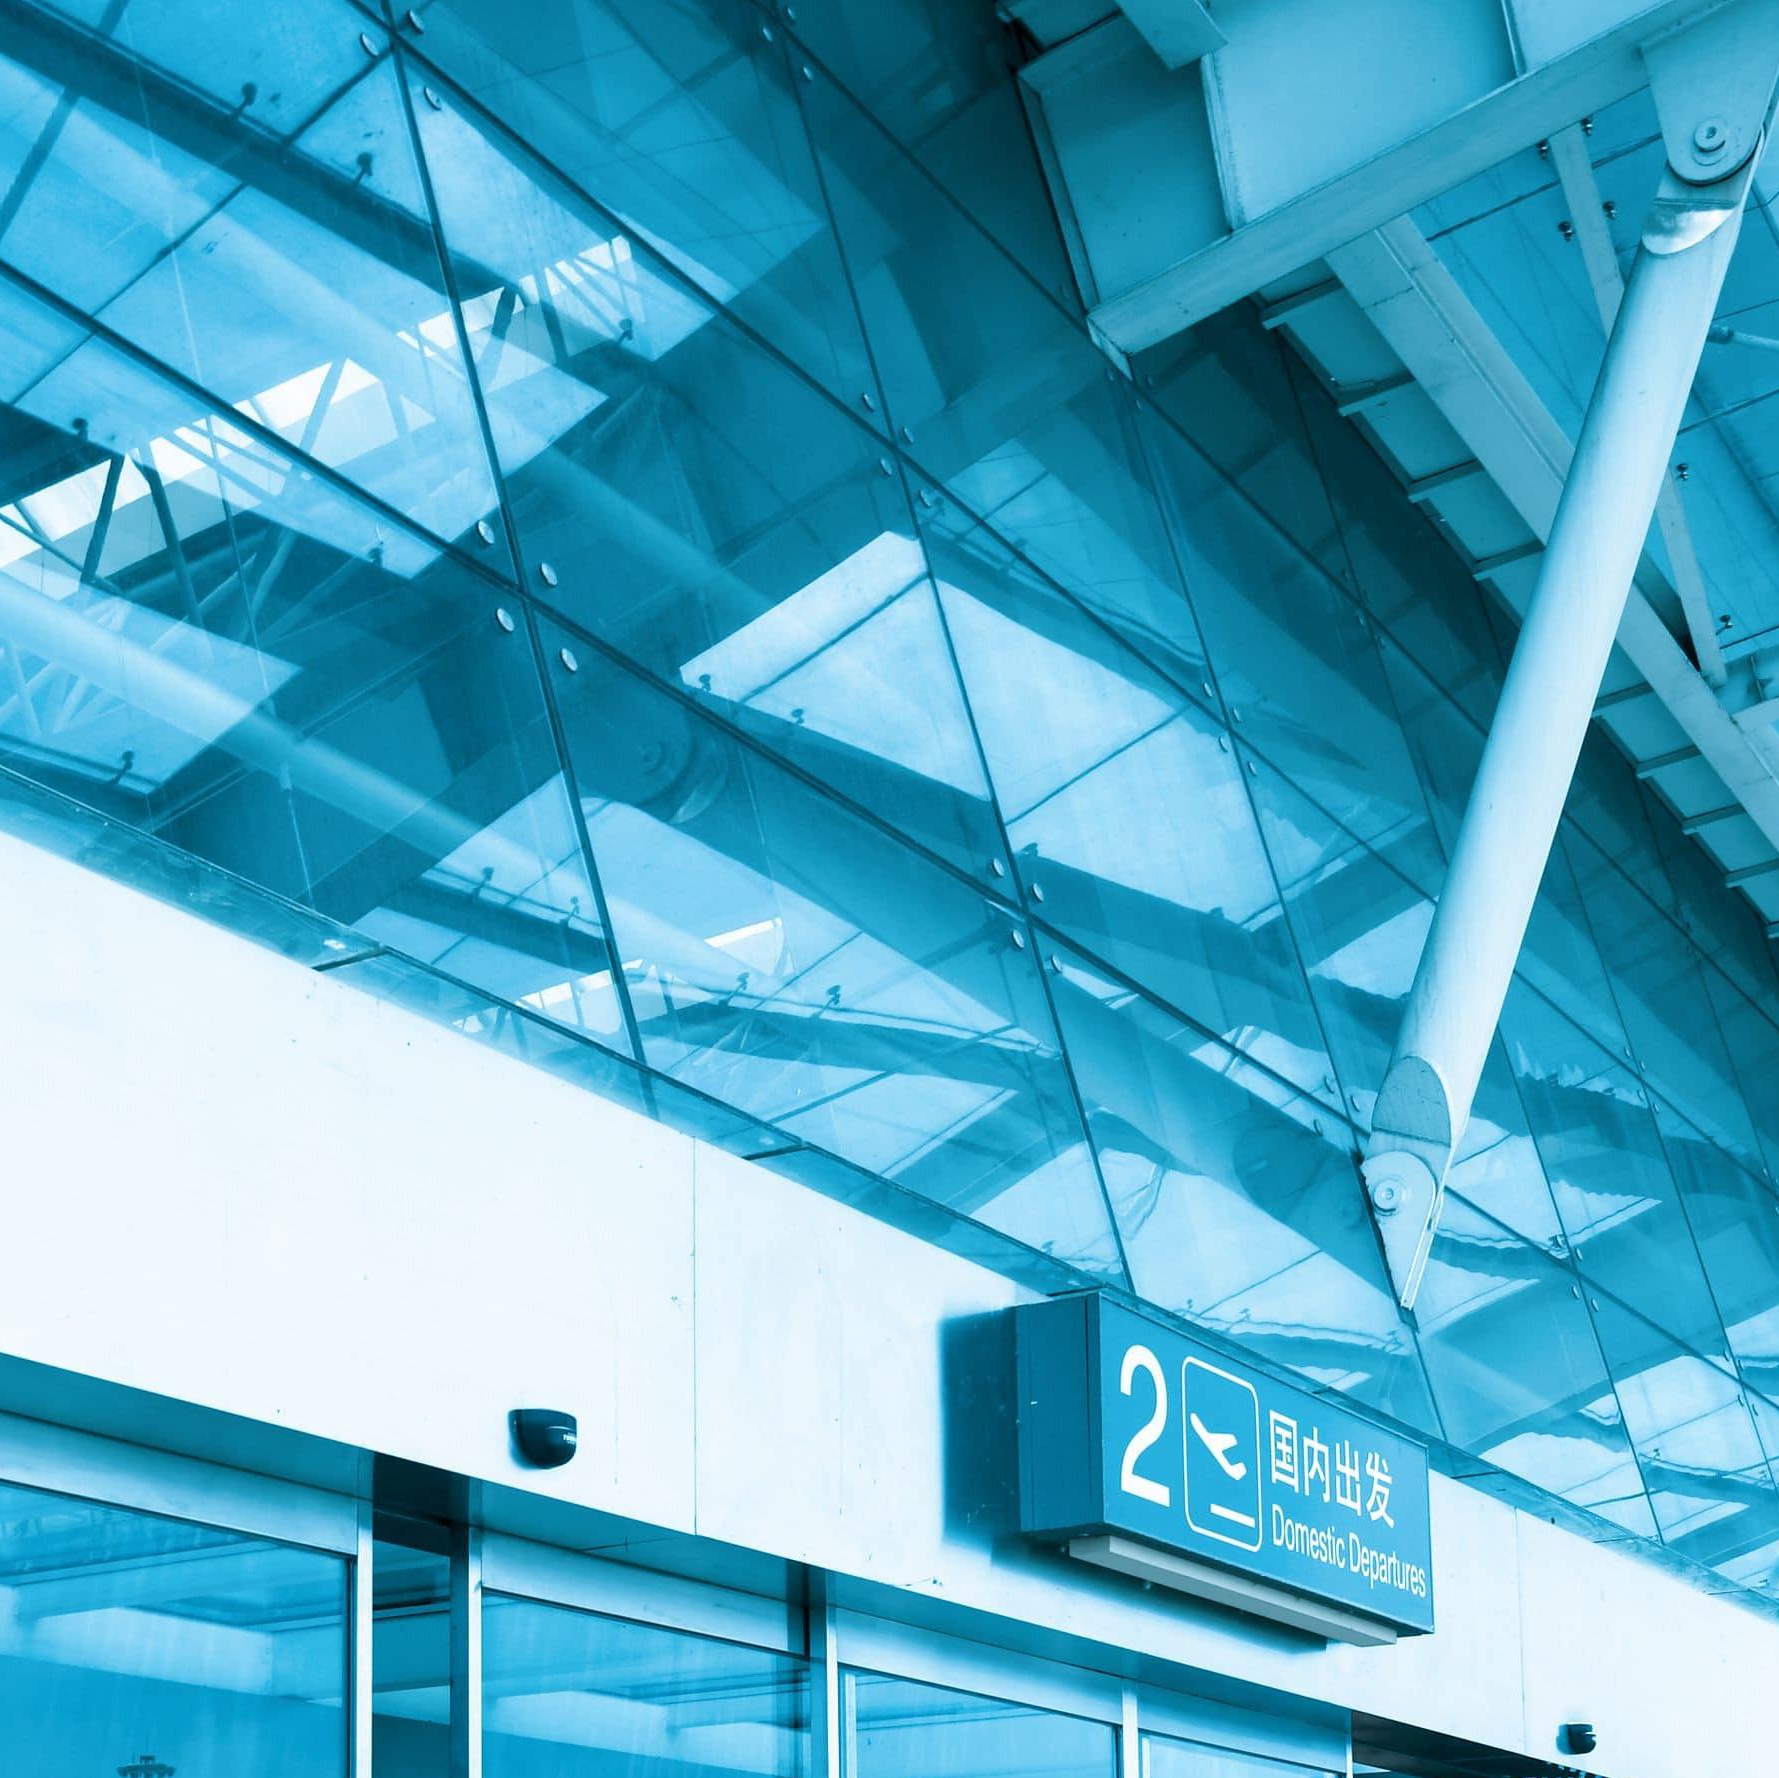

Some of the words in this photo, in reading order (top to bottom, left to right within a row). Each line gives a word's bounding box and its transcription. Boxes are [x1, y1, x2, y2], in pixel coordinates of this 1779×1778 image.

[1121, 1345, 1170, 1507] 2
[1268, 1409, 1395, 1529] 国内出发
[1272, 1503, 1346, 1569] Domestic
[1348, 1532, 1426, 1598] Departures
